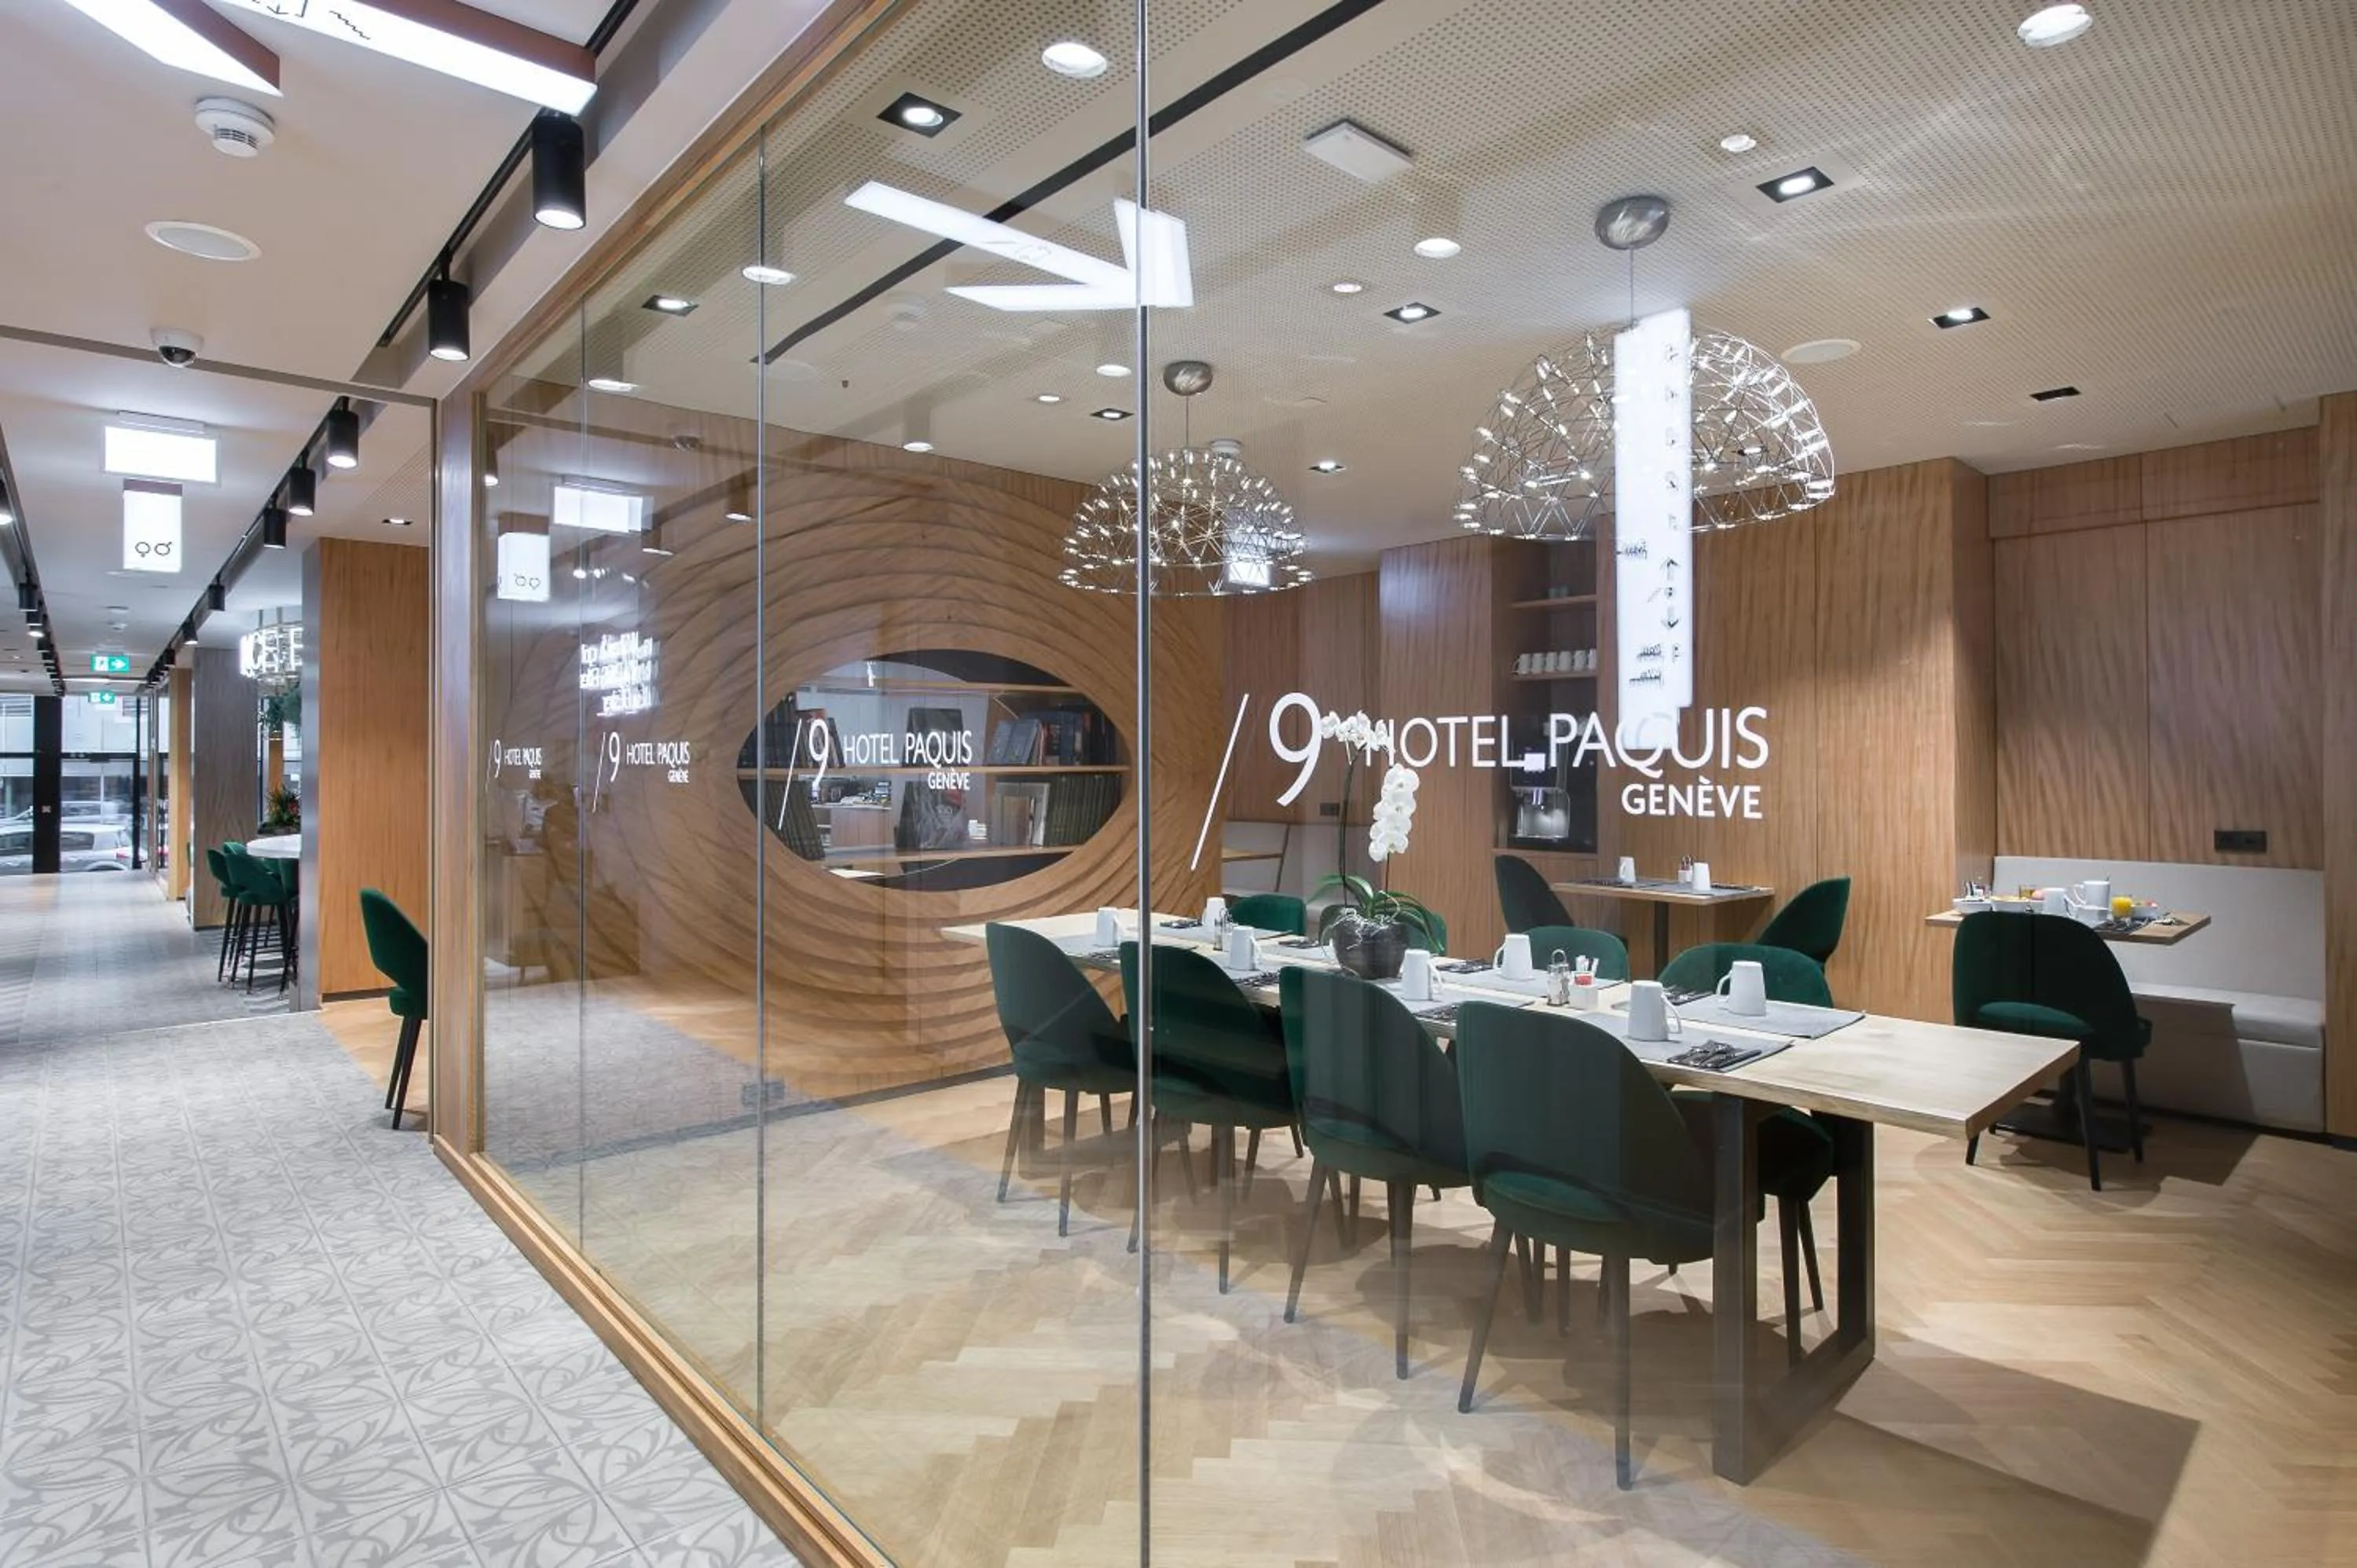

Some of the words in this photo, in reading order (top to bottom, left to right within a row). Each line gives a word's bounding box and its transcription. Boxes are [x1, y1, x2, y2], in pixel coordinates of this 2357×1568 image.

[626, 742, 655, 764] HOTEL
[657, 741, 691, 768] PAQUIS
[843, 734, 900, 764] HOTEL
[904, 731, 973, 769] PAQUIS
[1365, 716, 1525, 767] HOTEL
[1549, 706, 1769, 779] PAQUIS
[928, 768, 970, 790] GENÈVE
[1621, 775, 1762, 819] GENÈVE
